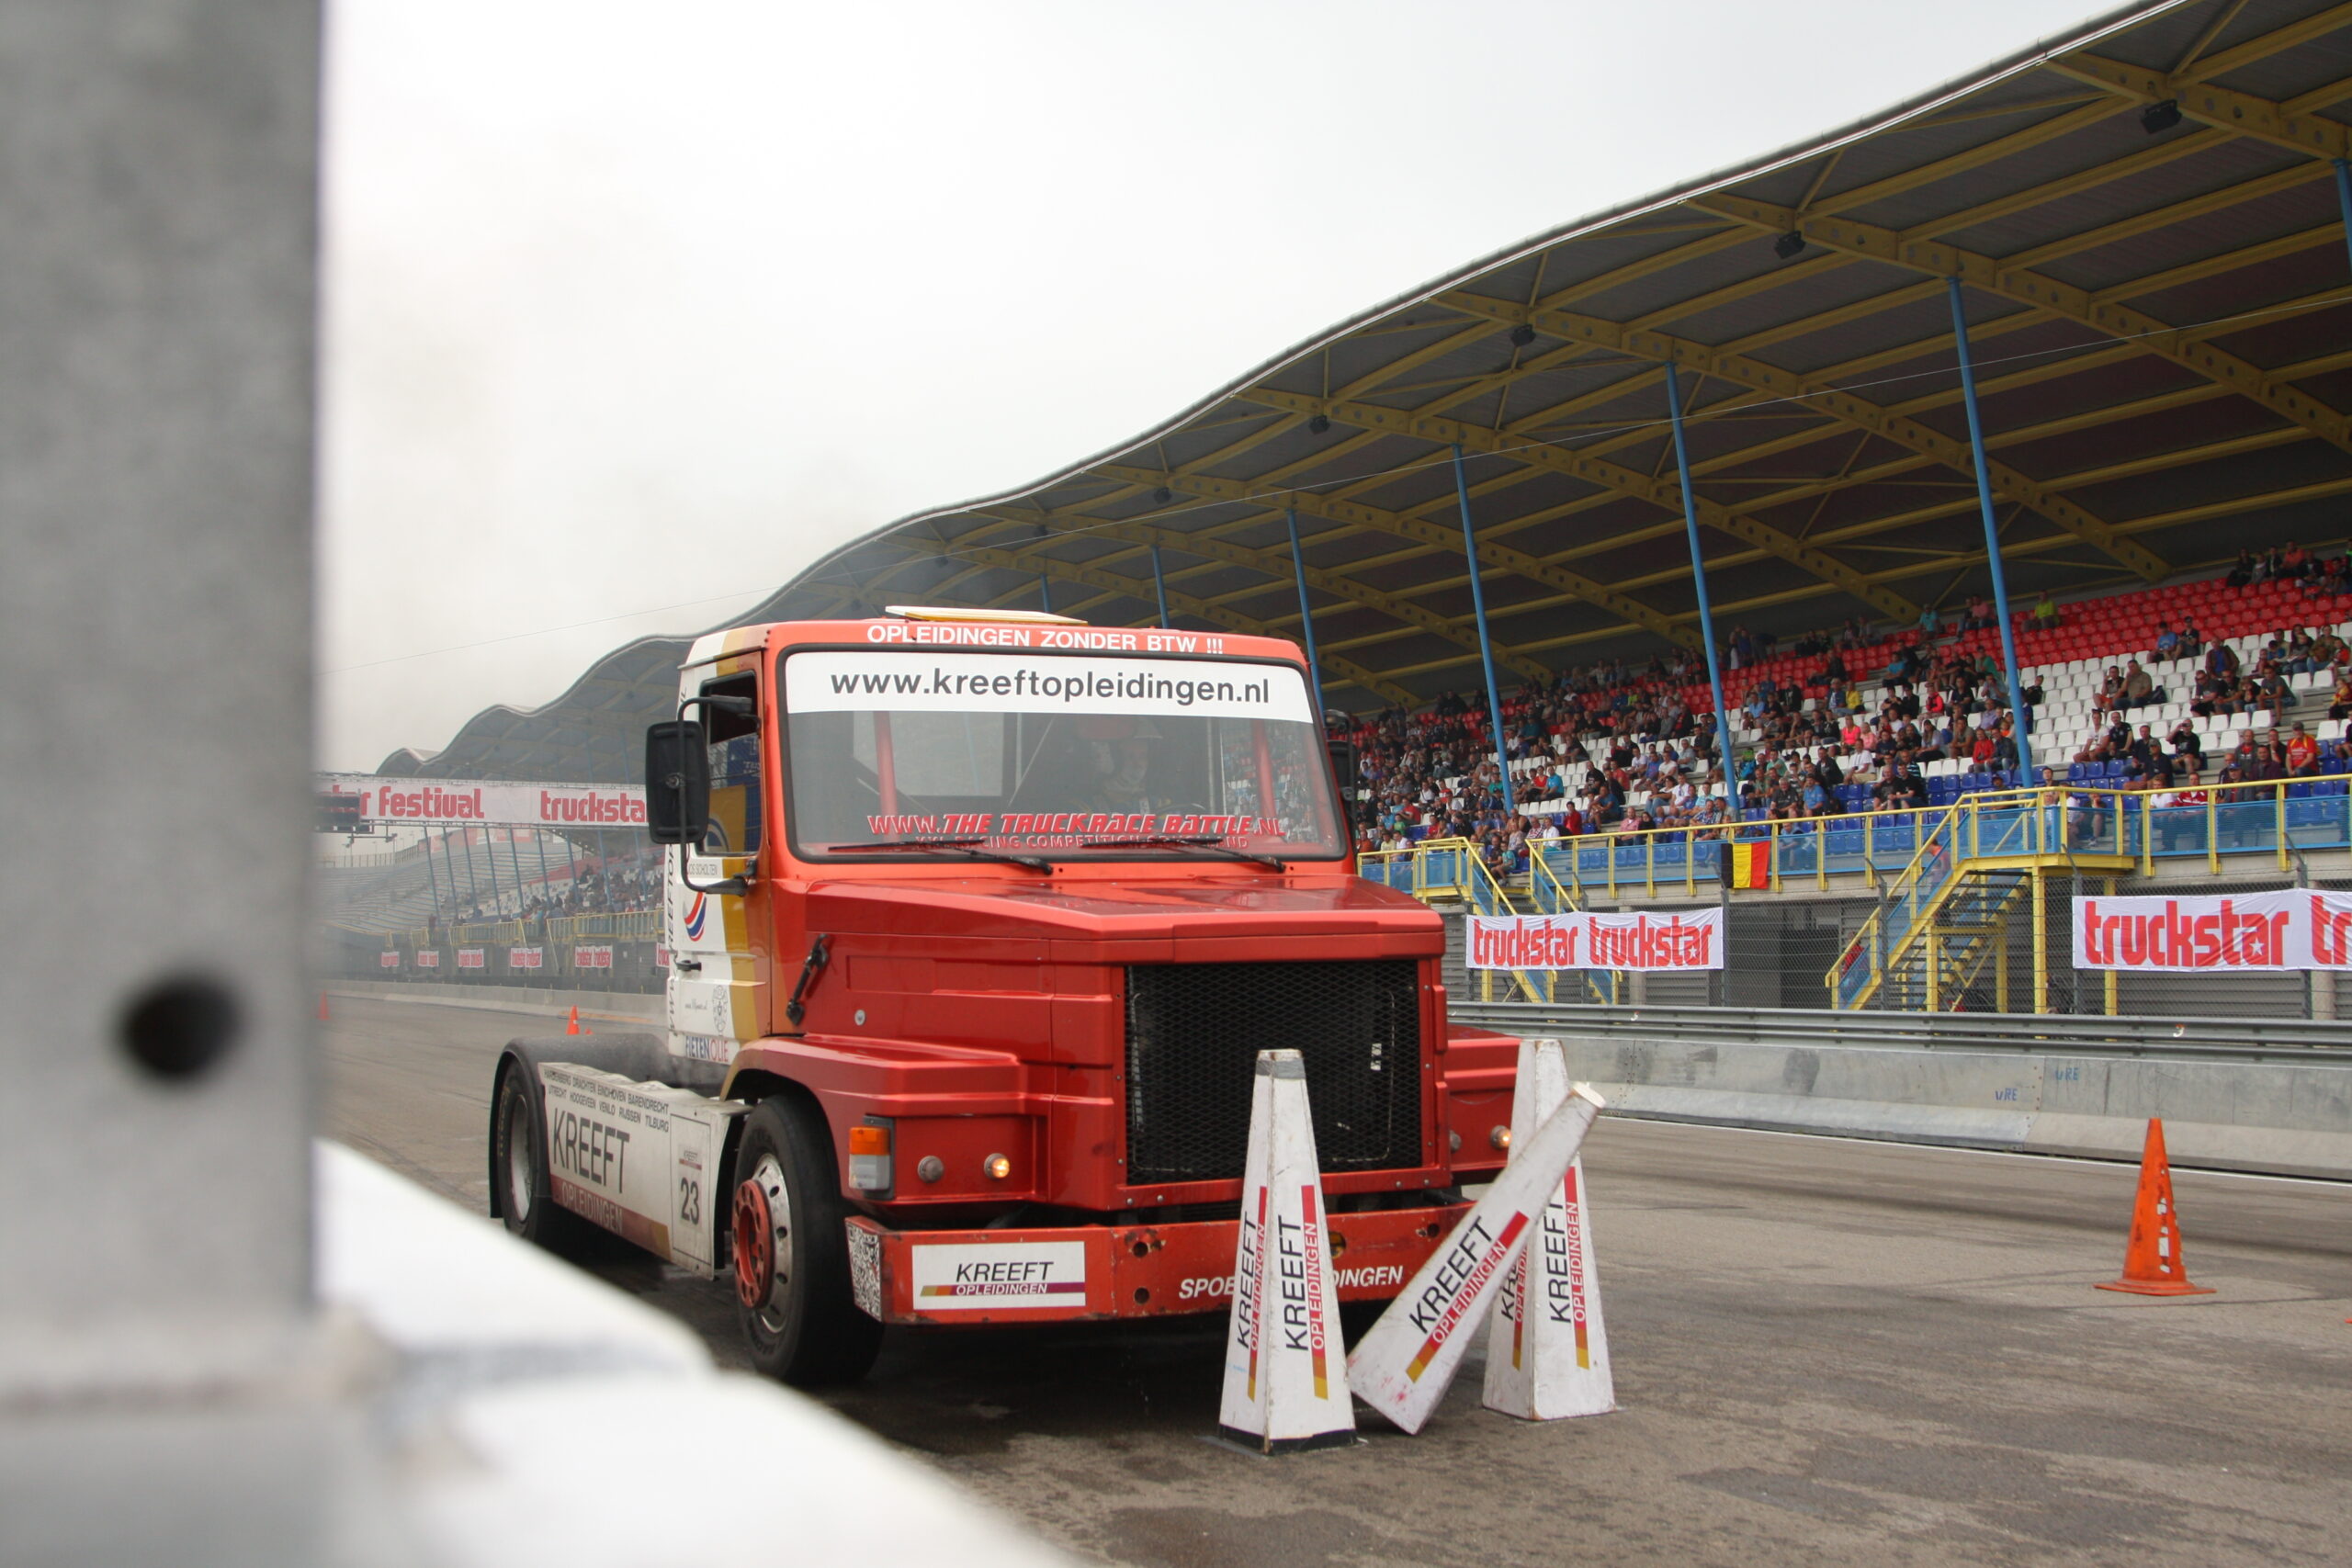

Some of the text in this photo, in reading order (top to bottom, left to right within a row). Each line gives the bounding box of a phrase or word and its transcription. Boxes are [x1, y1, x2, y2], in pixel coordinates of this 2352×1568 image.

[866, 625, 1224, 655] OPLEIDINGEN ZONDER BTW !!!
[830, 668, 1270, 706] www.kreeftopleidingen.nl
[379, 785, 485, 818] festival
[540, 790, 649, 823] trucksta
[1473, 915, 1713, 967] truckstar truckstar
[2085, 899, 2290, 967] truckstar
[599, 1100, 616, 1116] VENLO
[645, 1114, 669, 1134] TILBURG
[628, 1093, 669, 1115] BARENDRECHT
[553, 1108, 630, 1194] KREEFT
[561, 1181, 623, 1235] OPLEIDINGEN
[680, 1177, 699, 1225] 23
[956, 1261, 1054, 1283] KREEFT
[1179, 1276, 1236, 1299] SPOE
[1237, 1211, 1257, 1349] KREEFT
[1250, 1223, 1265, 1351] OPLEIDINGEN
[1278, 1213, 1309, 1350] KREEFT
[1305, 1222, 1325, 1350] OPLEIDINGEN
[1409, 1214, 1493, 1335] KREEFT
[1566, 1201, 1586, 1323] OPLEIDINGEN
[956, 1283, 1048, 1296] OPLEIDINGEN
[1432, 1239, 1508, 1343] OPLEIDINGEN
